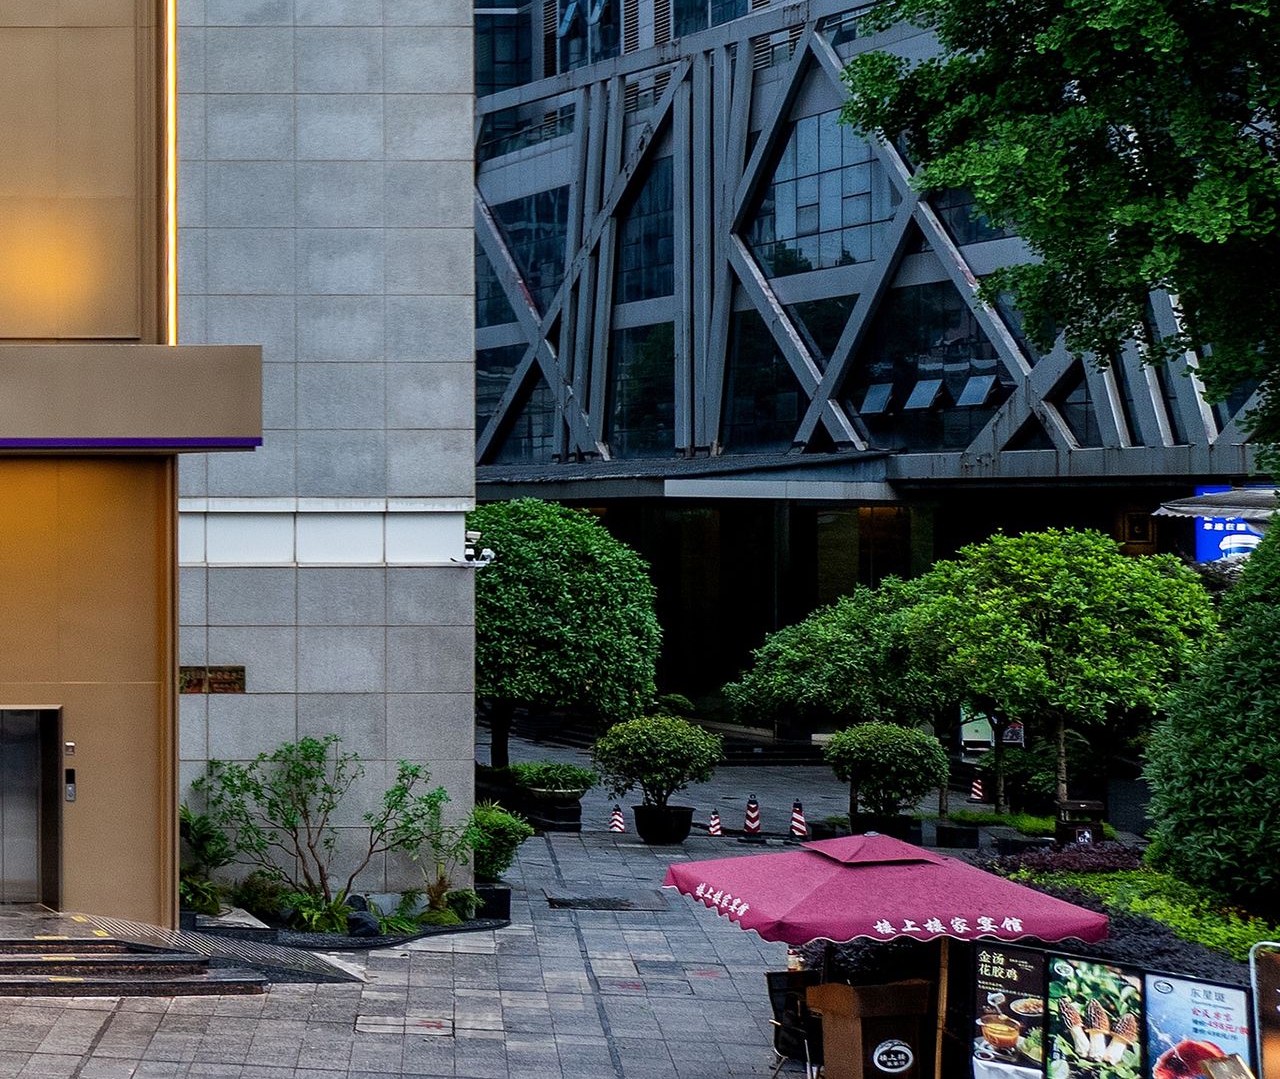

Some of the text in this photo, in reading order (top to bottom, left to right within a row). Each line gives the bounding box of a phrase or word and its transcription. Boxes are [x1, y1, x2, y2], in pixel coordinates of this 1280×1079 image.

[872, 916, 1023, 934] 楼上楼家宴馆
[978, 950, 1005, 967] 金汤
[978, 963, 1018, 982] 花胶鸡
